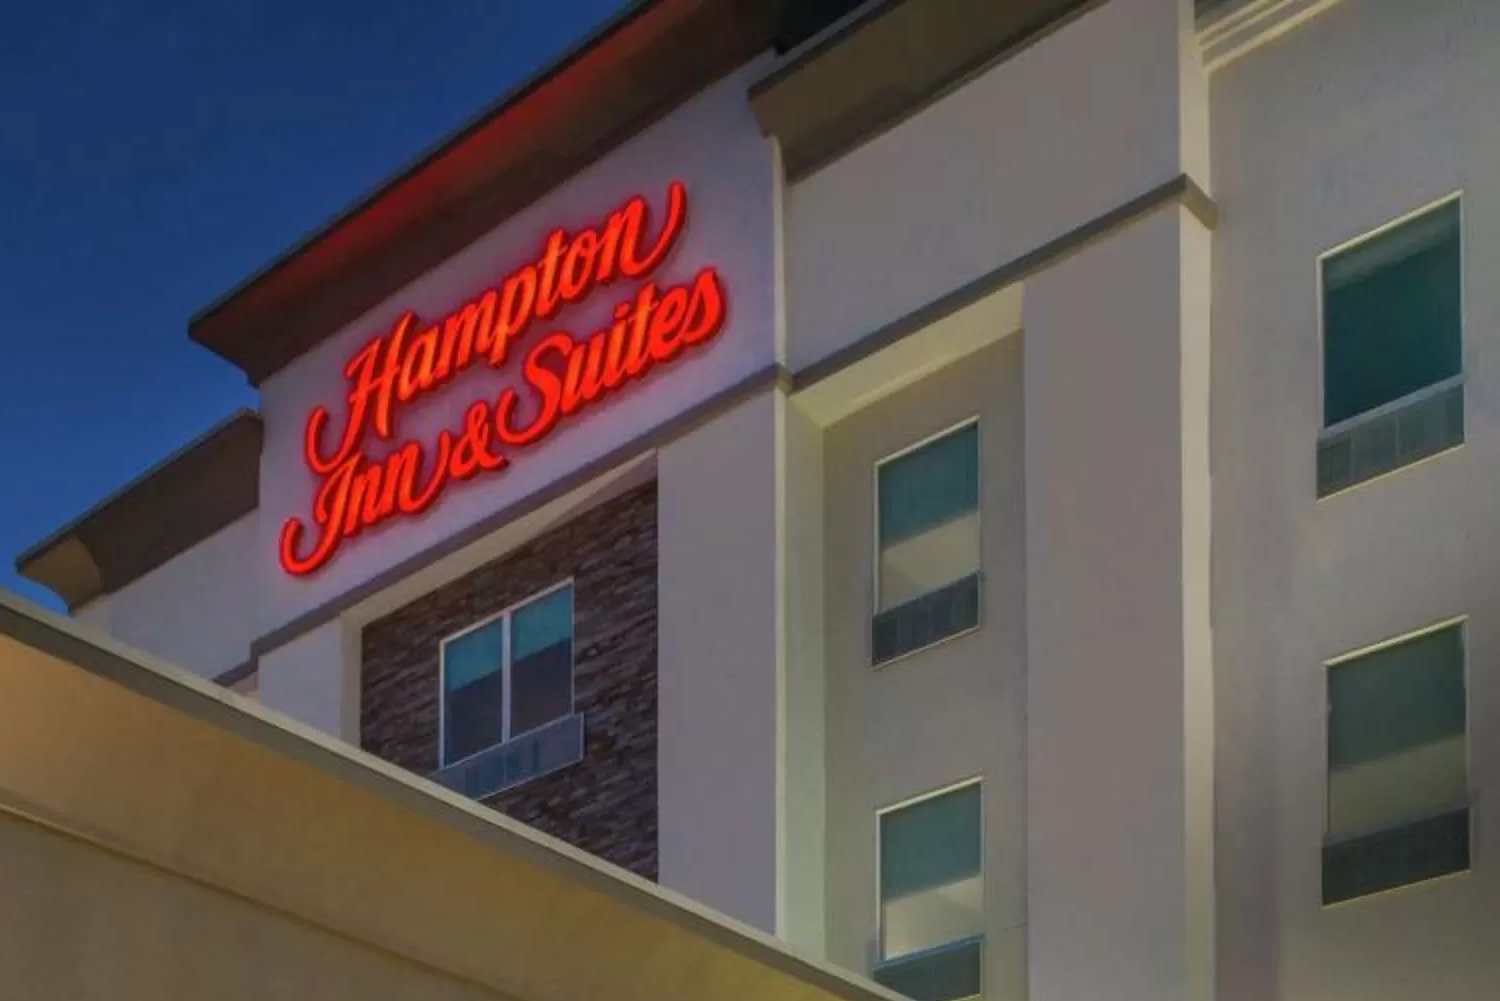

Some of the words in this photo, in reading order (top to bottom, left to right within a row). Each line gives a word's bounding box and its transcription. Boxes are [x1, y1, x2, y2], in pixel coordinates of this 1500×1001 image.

[280, 431, 451, 574] Inn
[449, 401, 506, 478] &
[499, 266, 726, 445] Suites
[307, 180, 687, 473] Hampton
